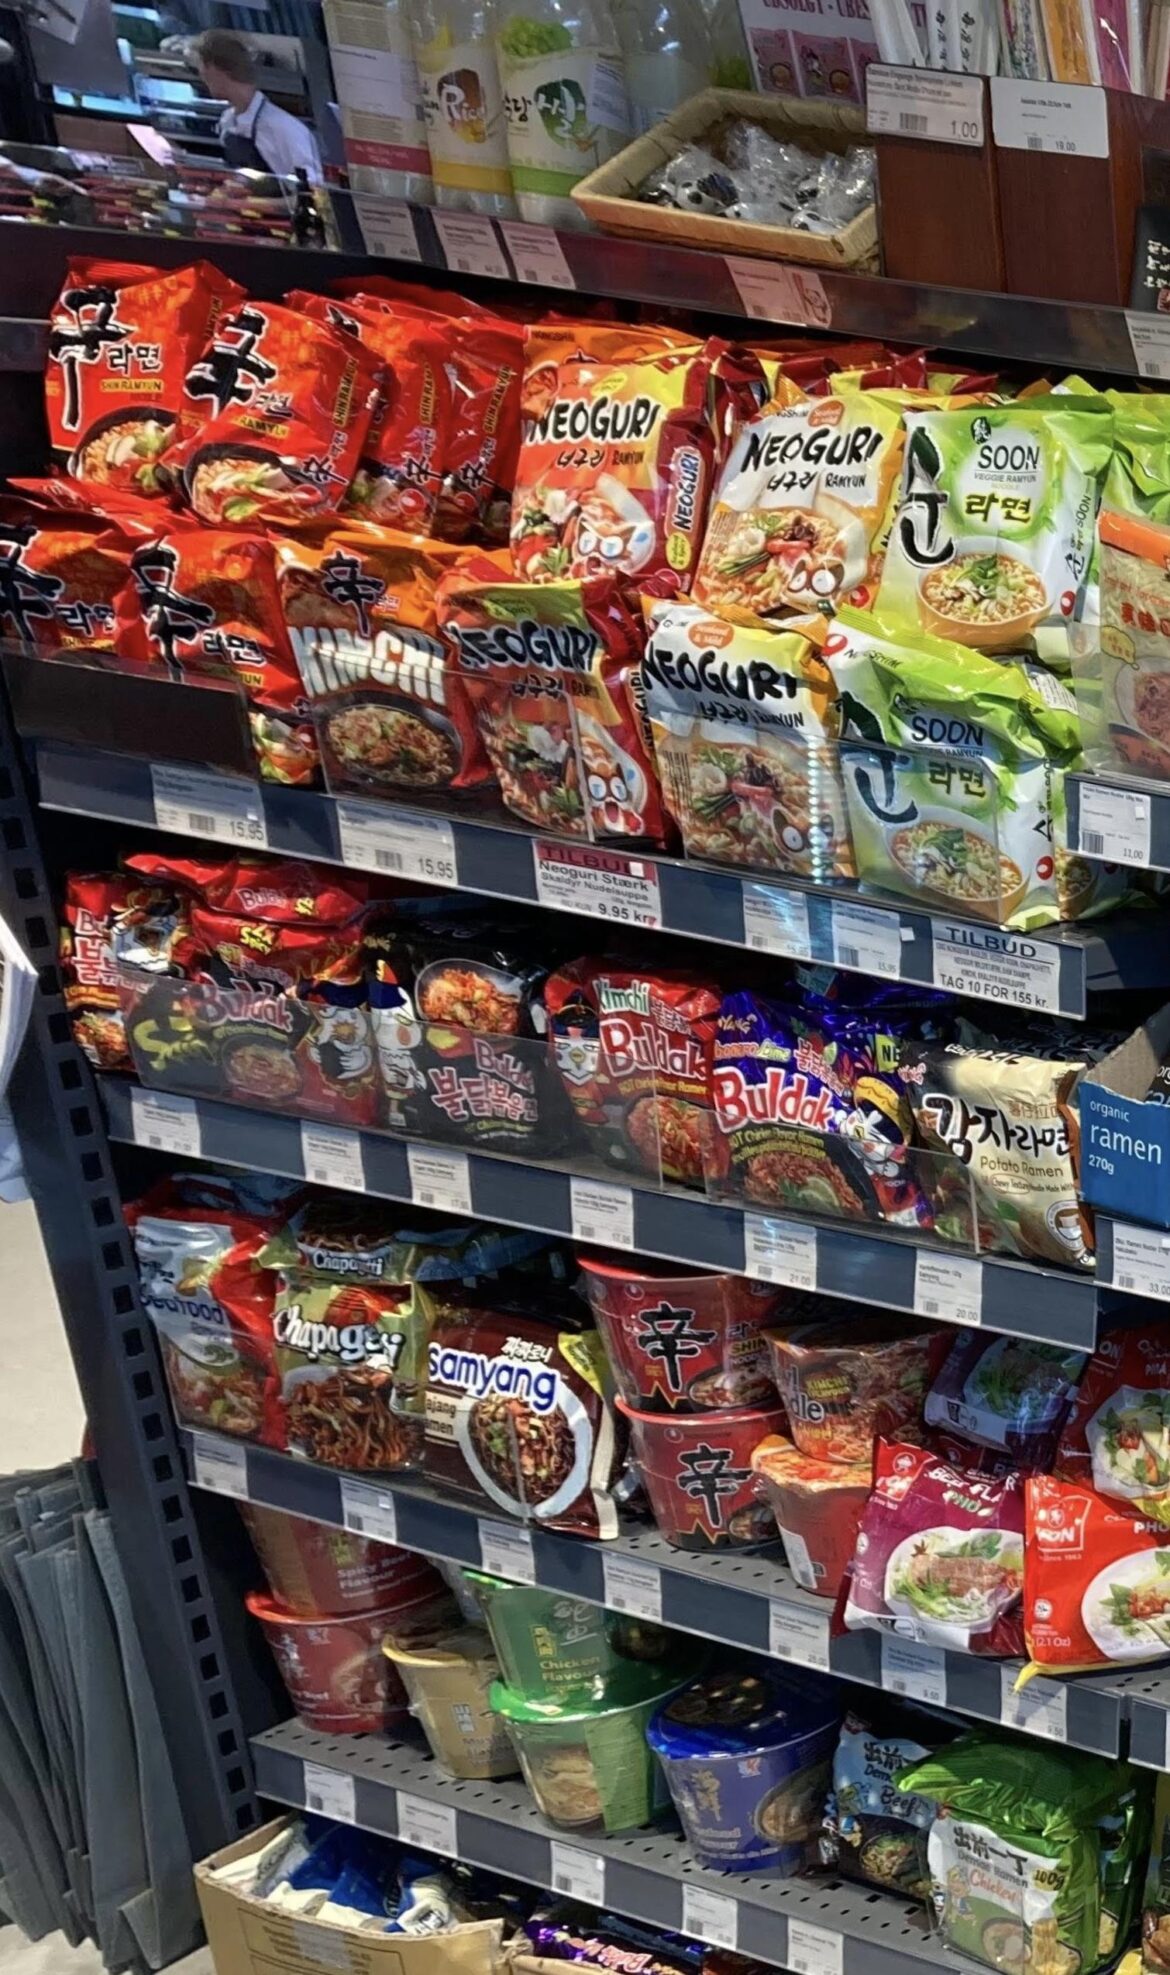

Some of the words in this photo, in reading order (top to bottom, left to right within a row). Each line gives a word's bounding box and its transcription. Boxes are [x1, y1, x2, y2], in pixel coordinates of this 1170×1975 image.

[107, 343, 162, 374] 라면
[528, 396, 662, 443] NEOGURI
[740, 426, 884, 473] NEOGURI
[977, 445, 1041, 471] SOON
[672, 453, 700, 531] NEOGURI
[825, 472, 867, 488] RAMYUN
[965, 493, 1032, 524] 라면
[642, 640, 798, 701] NEOGURI
[911, 716, 984, 747] SOON
[929, 761, 987, 798] 라면
[539, 861, 597, 882] Neoguri
[602, 873, 649, 892] Stærk
[543, 845, 632, 876] TILBU
[945, 926, 1037, 958] TILBUD
[192, 972, 293, 1033] Buldak
[940, 974, 964, 990] TAG
[968, 980, 981, 993] 10
[984, 983, 1009, 1000] FOR
[1013, 990, 1032, 1005] 155
[599, 1018, 708, 1081] Buldak
[713, 1066, 835, 1133] Buldak
[1089, 1099, 1130, 1123] organic
[1091, 1123, 1163, 1165] ramen
[980, 1156, 1020, 1174] Potato
[1022, 1161, 1064, 1178] Ramen
[1088, 1154, 1115, 1176] 270g
[637, 1301, 717, 1393] 辛
[429, 1348, 557, 1411] samyang
[676, 1443, 754, 1528] 辛
[539, 1656, 601, 1670] Chicken
[880, 1786, 921, 1817] Beef
[953, 1825, 1029, 1876] 出前一丁
[968, 1869, 1022, 1903] Chicken
[1034, 1869, 1066, 1891] 100g
